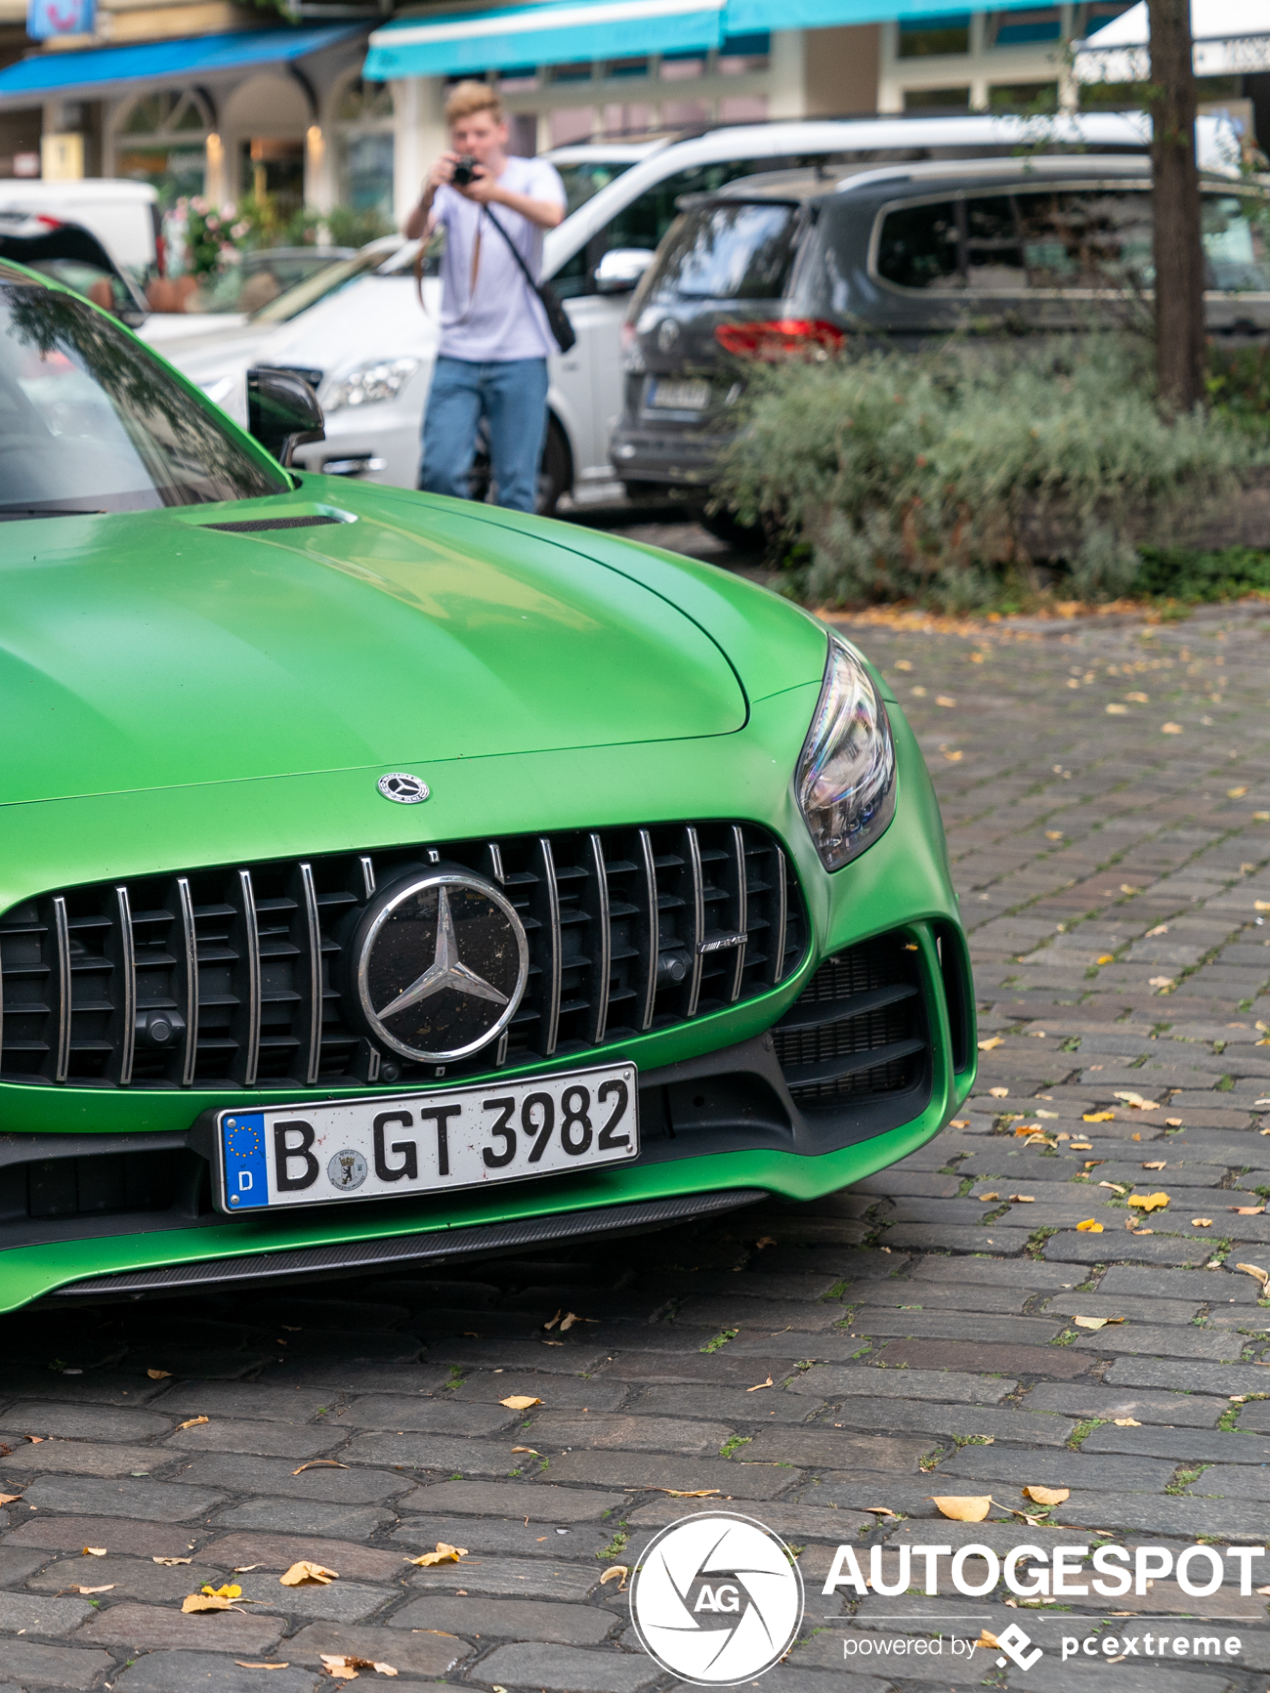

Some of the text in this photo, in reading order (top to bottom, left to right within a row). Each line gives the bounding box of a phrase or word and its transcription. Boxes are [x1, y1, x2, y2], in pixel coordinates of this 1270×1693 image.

[273, 1079, 631, 1193] B GT 3982
[238, 1170, 253, 1191] D
